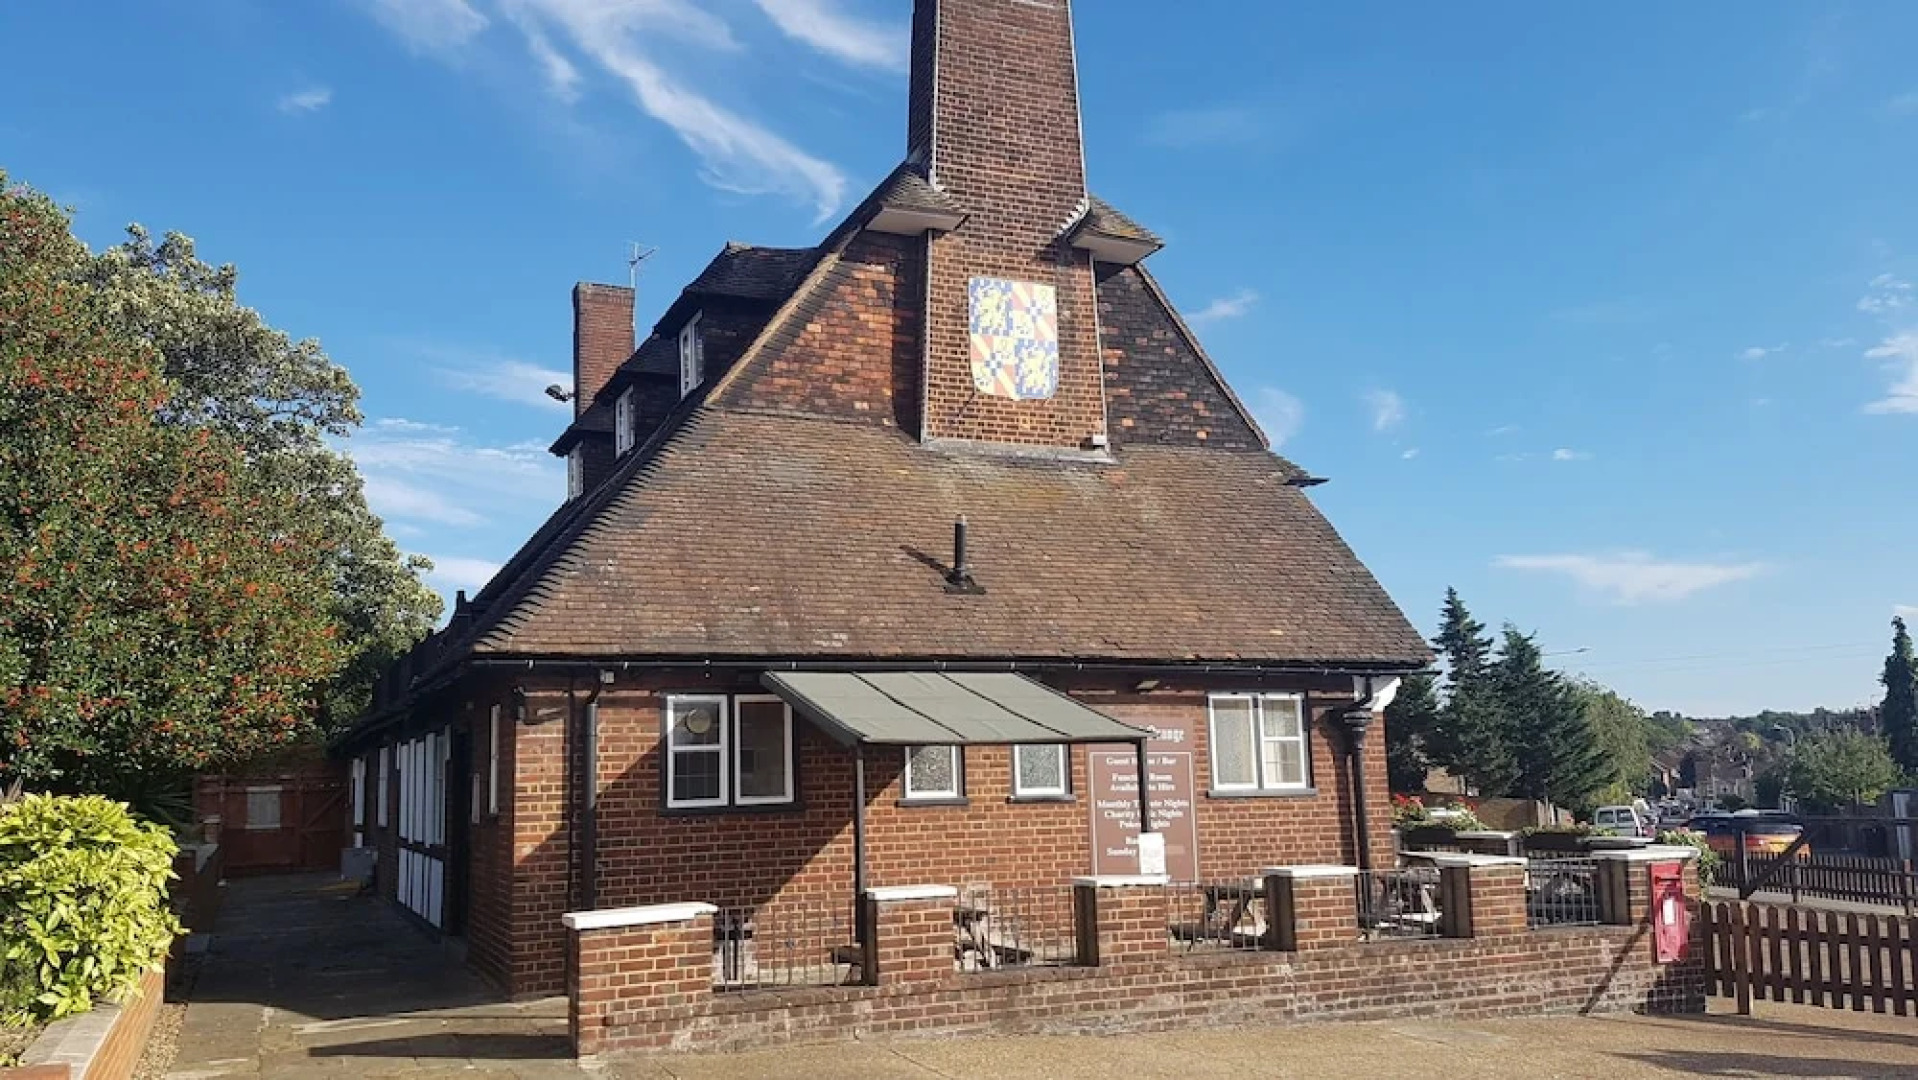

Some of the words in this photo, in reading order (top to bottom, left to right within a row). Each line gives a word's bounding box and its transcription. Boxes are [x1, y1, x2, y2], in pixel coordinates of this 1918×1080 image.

[1096, 800, 1131, 810] Monthly
[1163, 799, 1190, 809] Nights
[1104, 810, 1135, 819] Charity
[1157, 809, 1184, 819] Nights
[1149, 819, 1171, 829] ights
[1106, 847, 1137, 857] Sunday
